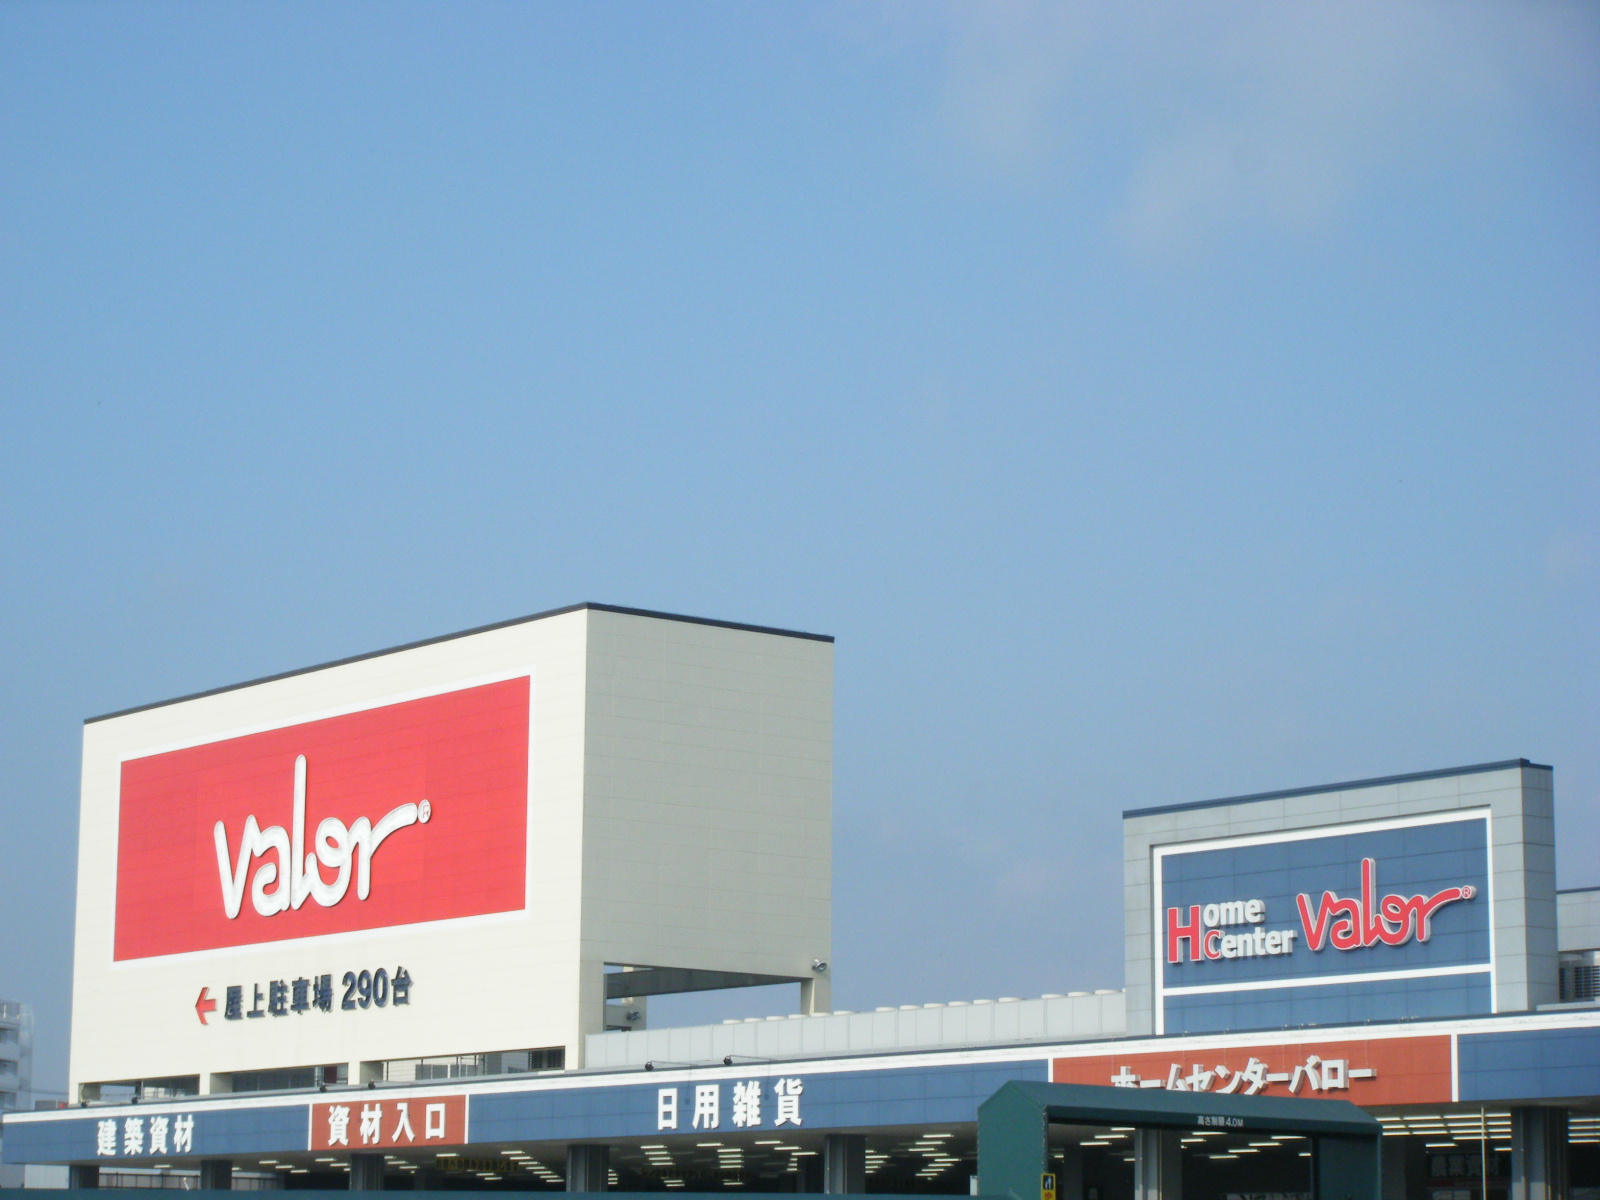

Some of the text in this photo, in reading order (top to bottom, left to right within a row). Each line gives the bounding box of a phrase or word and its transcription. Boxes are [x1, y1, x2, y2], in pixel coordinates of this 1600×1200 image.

[224, 974, 334, 1020] 屋上駐車場
[327, 1102, 446, 1147] 資材入口
[657, 1078, 804, 1131] 日用雑貨
[97, 1114, 195, 1156] 建築資材
